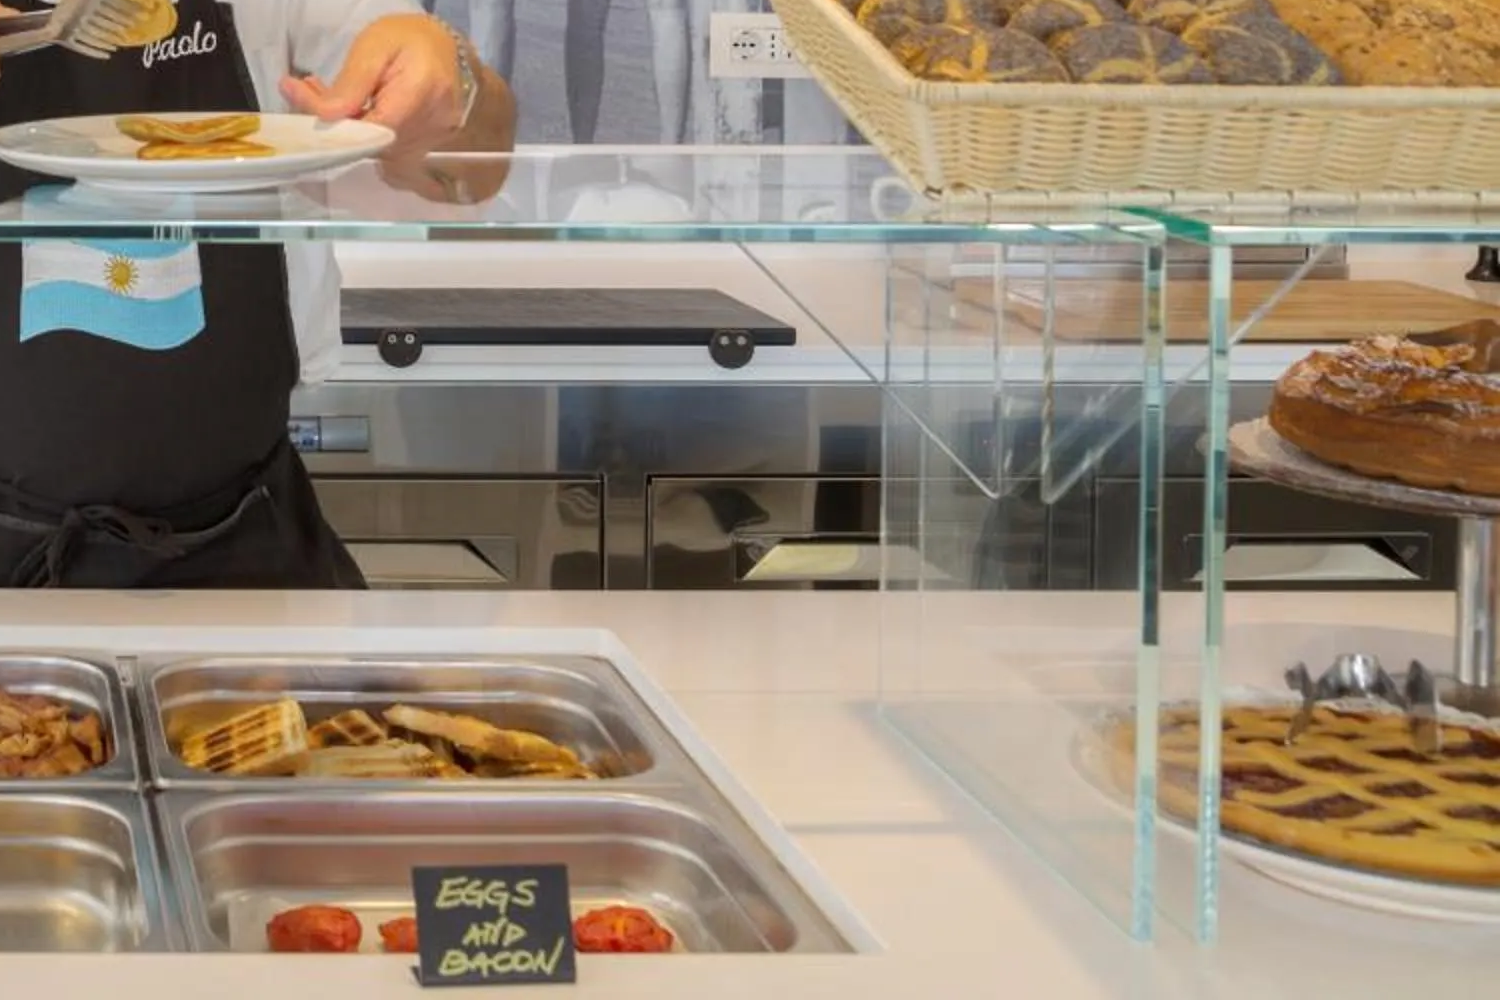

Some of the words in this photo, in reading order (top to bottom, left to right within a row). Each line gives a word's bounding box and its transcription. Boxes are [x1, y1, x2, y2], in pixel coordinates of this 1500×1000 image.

[435, 876, 539, 914] EGGS
[461, 916, 527, 947] AND
[437, 936, 565, 978] BACON
